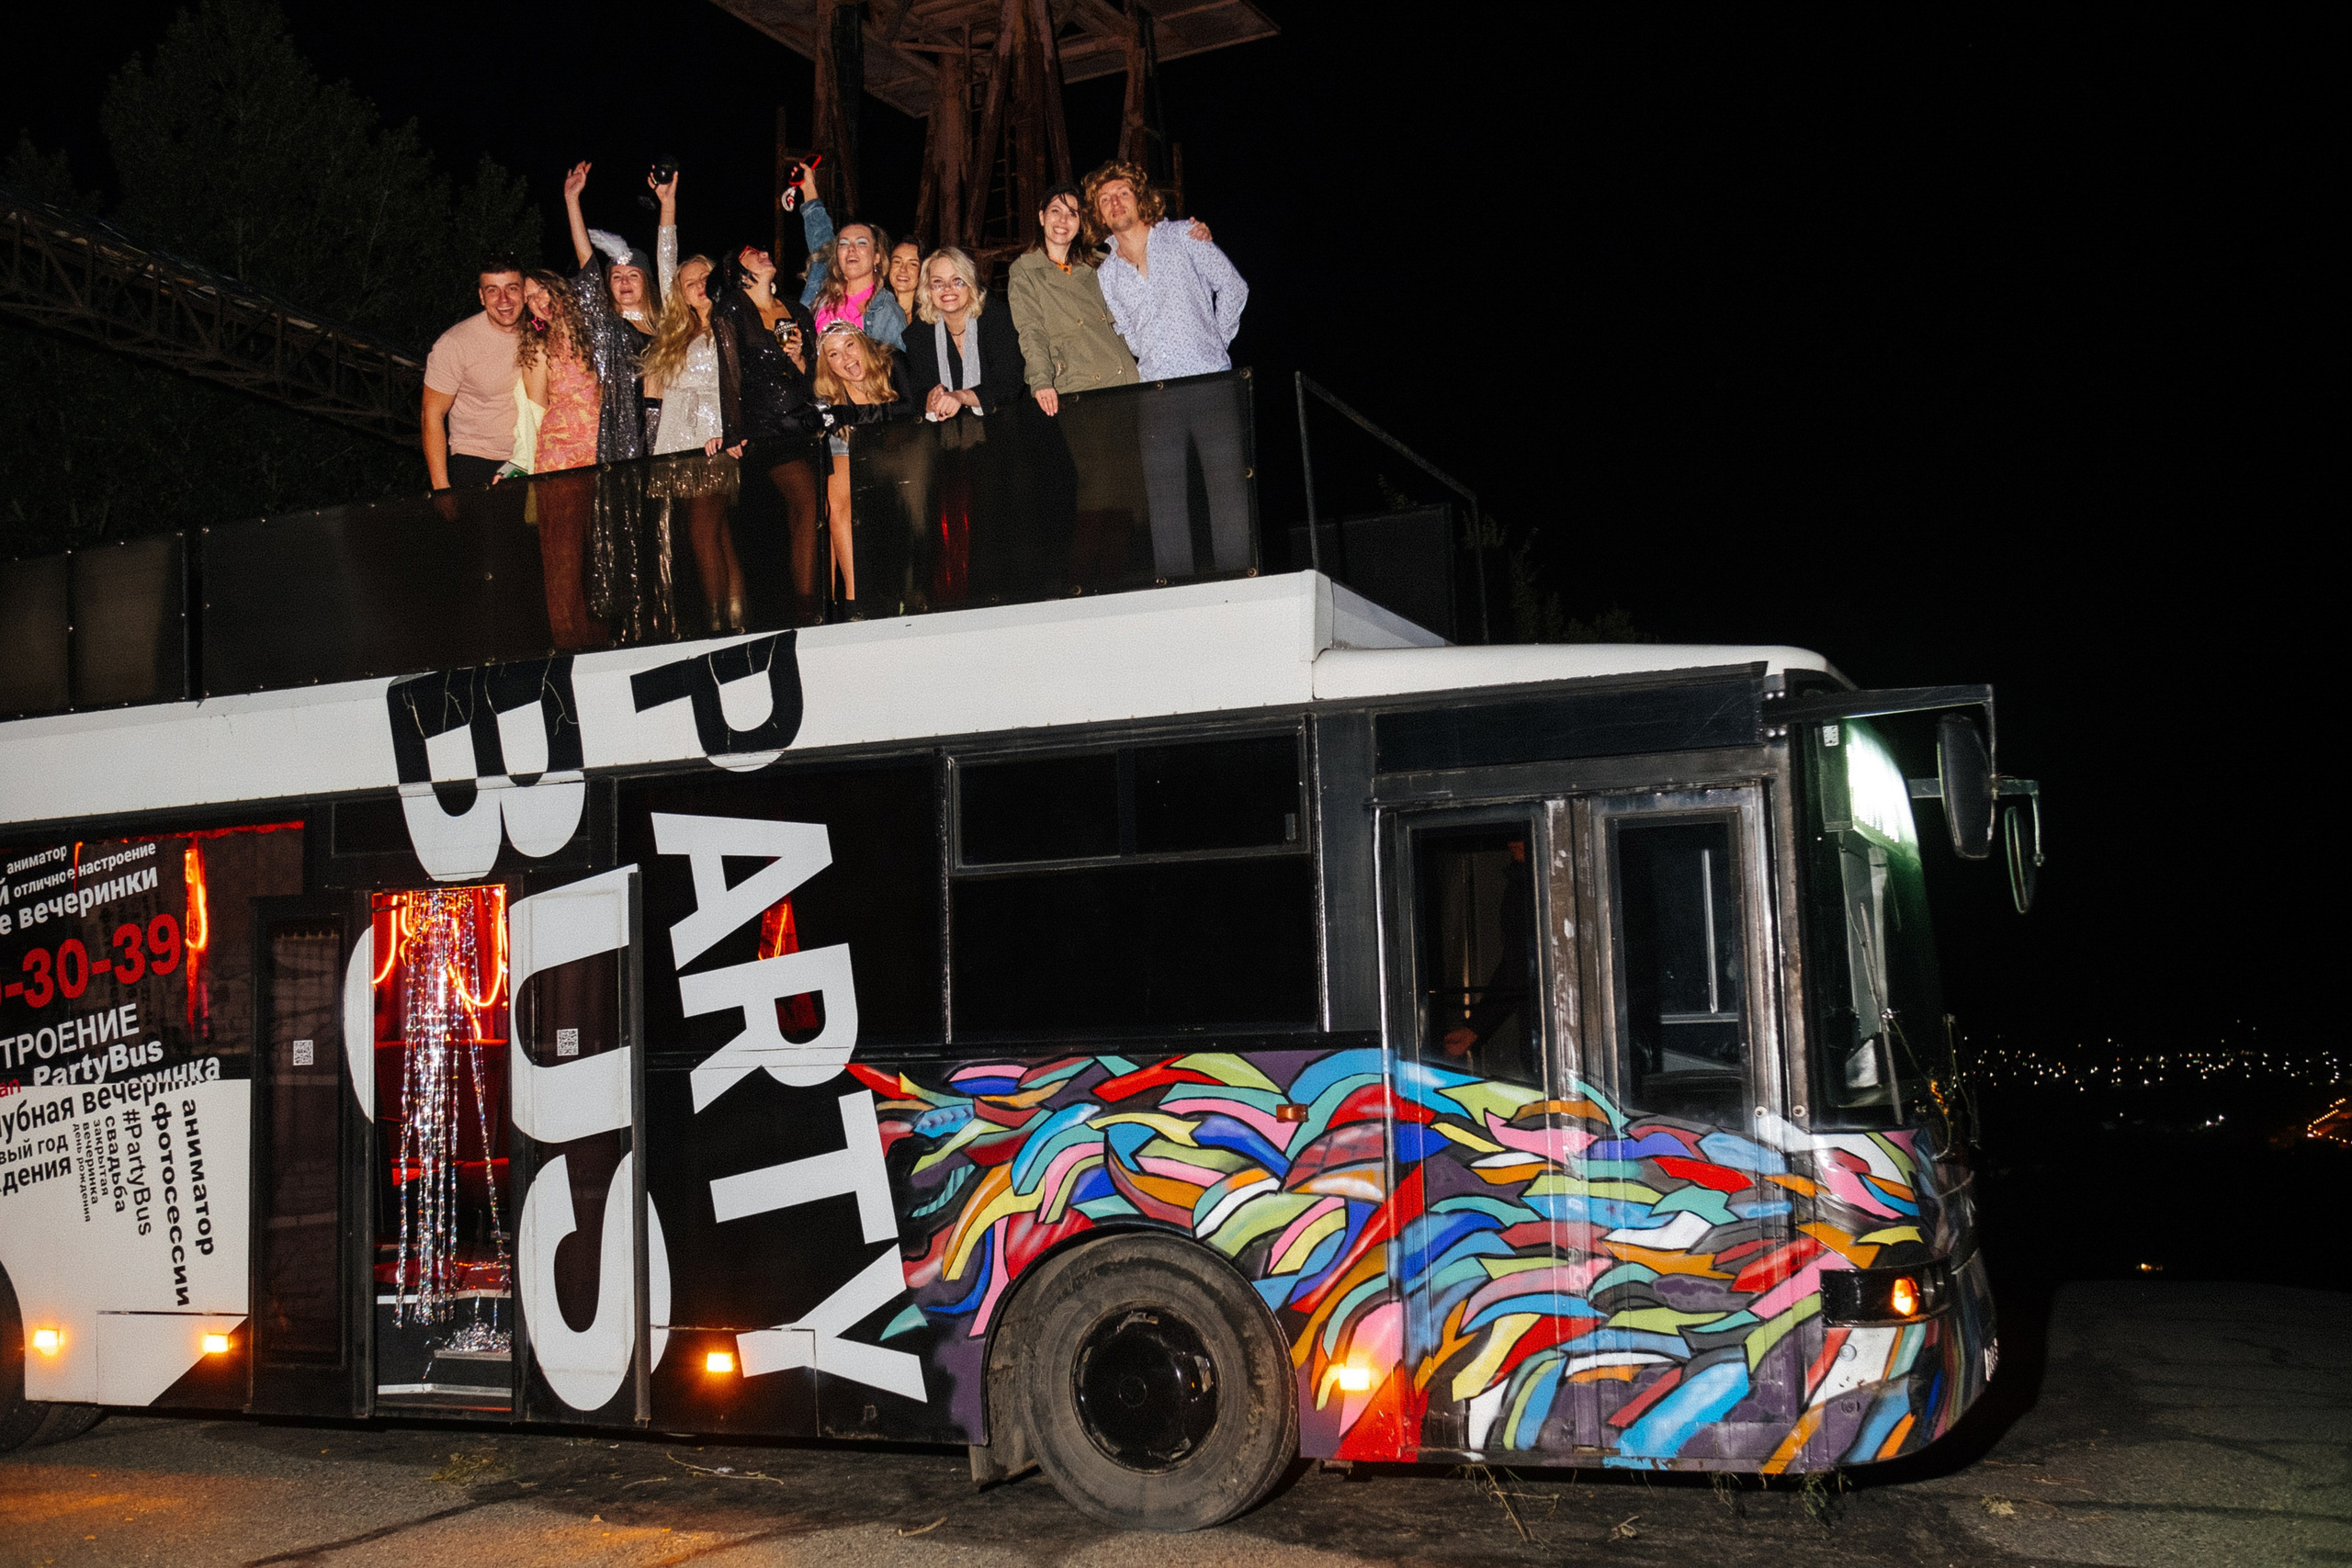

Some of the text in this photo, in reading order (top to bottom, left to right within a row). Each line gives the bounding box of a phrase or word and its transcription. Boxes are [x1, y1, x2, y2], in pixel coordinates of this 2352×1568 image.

[6, 845, 67, 874] аниматор
[14, 842, 156, 897] отличное настроение
[18, 866, 158, 930] вечеринки
[0, 913, 181, 1009] -30-39
[0, 1003, 140, 1069] ТРОЕНИЕ
[345, 655, 671, 1411] BUS
[630, 629, 927, 1403] PARTY
[0, 1056, 220, 1145] убная вечеринка
[33, 1040, 164, 1087] PartyBus
[0, 1156, 72, 1197] дения
[38, 1134, 68, 1154] год
[73, 1123, 91, 1223] день рождения
[83, 1122, 98, 1205] вечеринка
[93, 1120, 108, 1196] закрытая
[105, 1115, 128, 1213] свадьба
[122, 1109, 152, 1235] #PartyBus
[182, 1099, 214, 1256] аниматор
[151, 1101, 190, 1306] фотосессии
